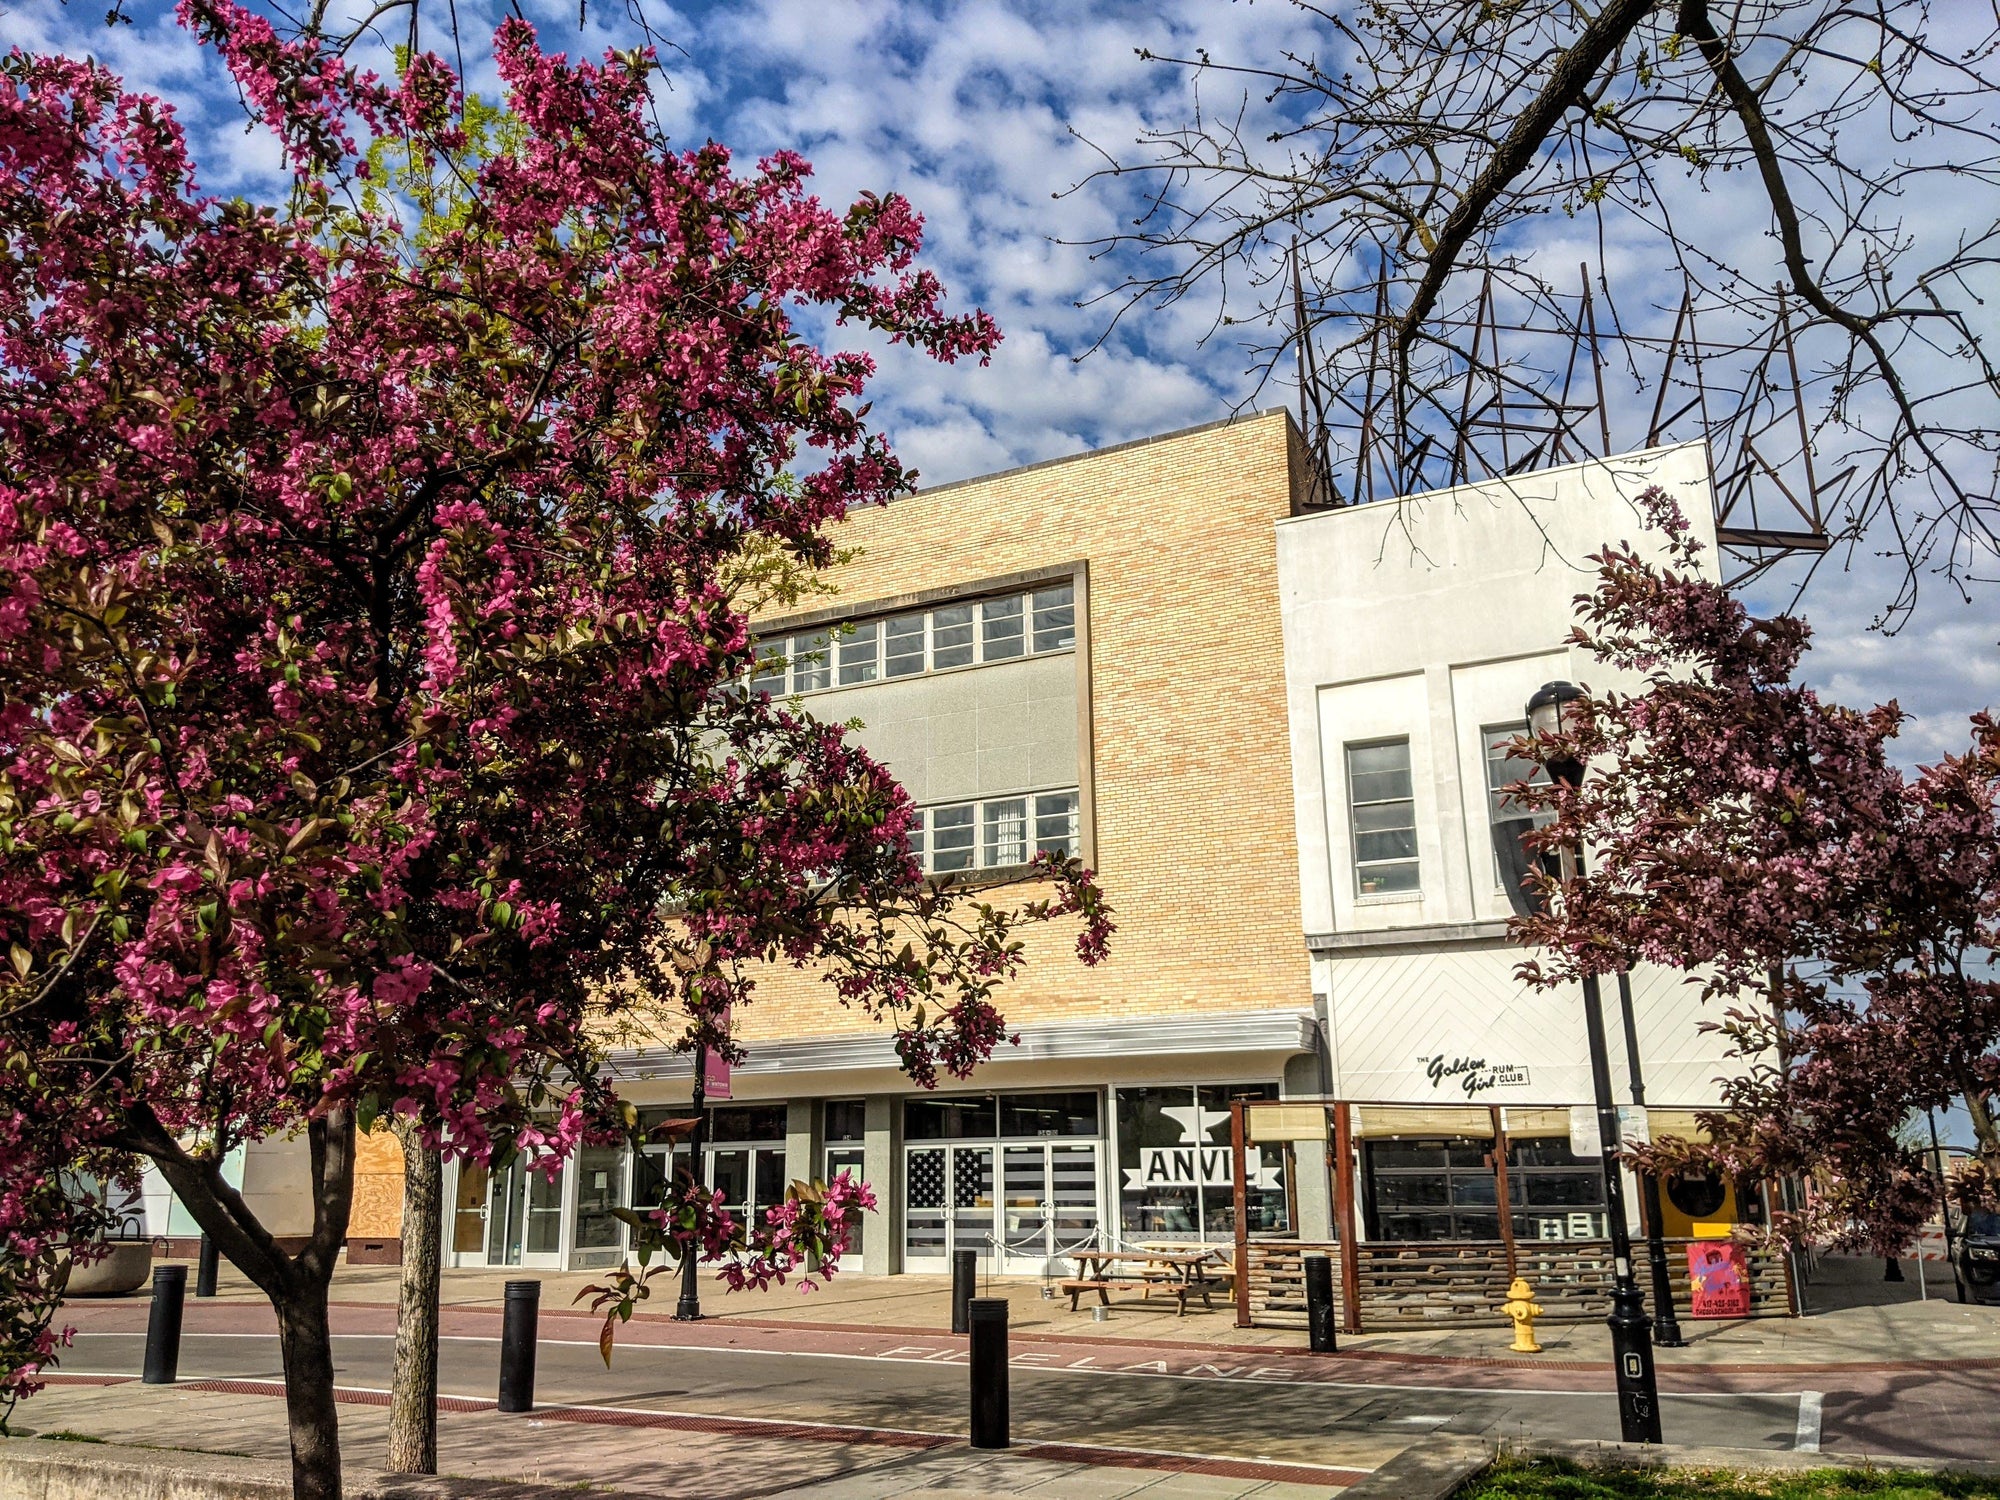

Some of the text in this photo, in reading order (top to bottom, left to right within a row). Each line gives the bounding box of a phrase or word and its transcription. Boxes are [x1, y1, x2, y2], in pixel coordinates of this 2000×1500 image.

[1426, 1054, 1486, 1089] Golden
[1492, 1064, 1514, 1074] RUM
[1499, 1073, 1524, 1083] CLUB
[1462, 1071, 1496, 1100] Girl
[1065, 1356, 1303, 1381] LANE
